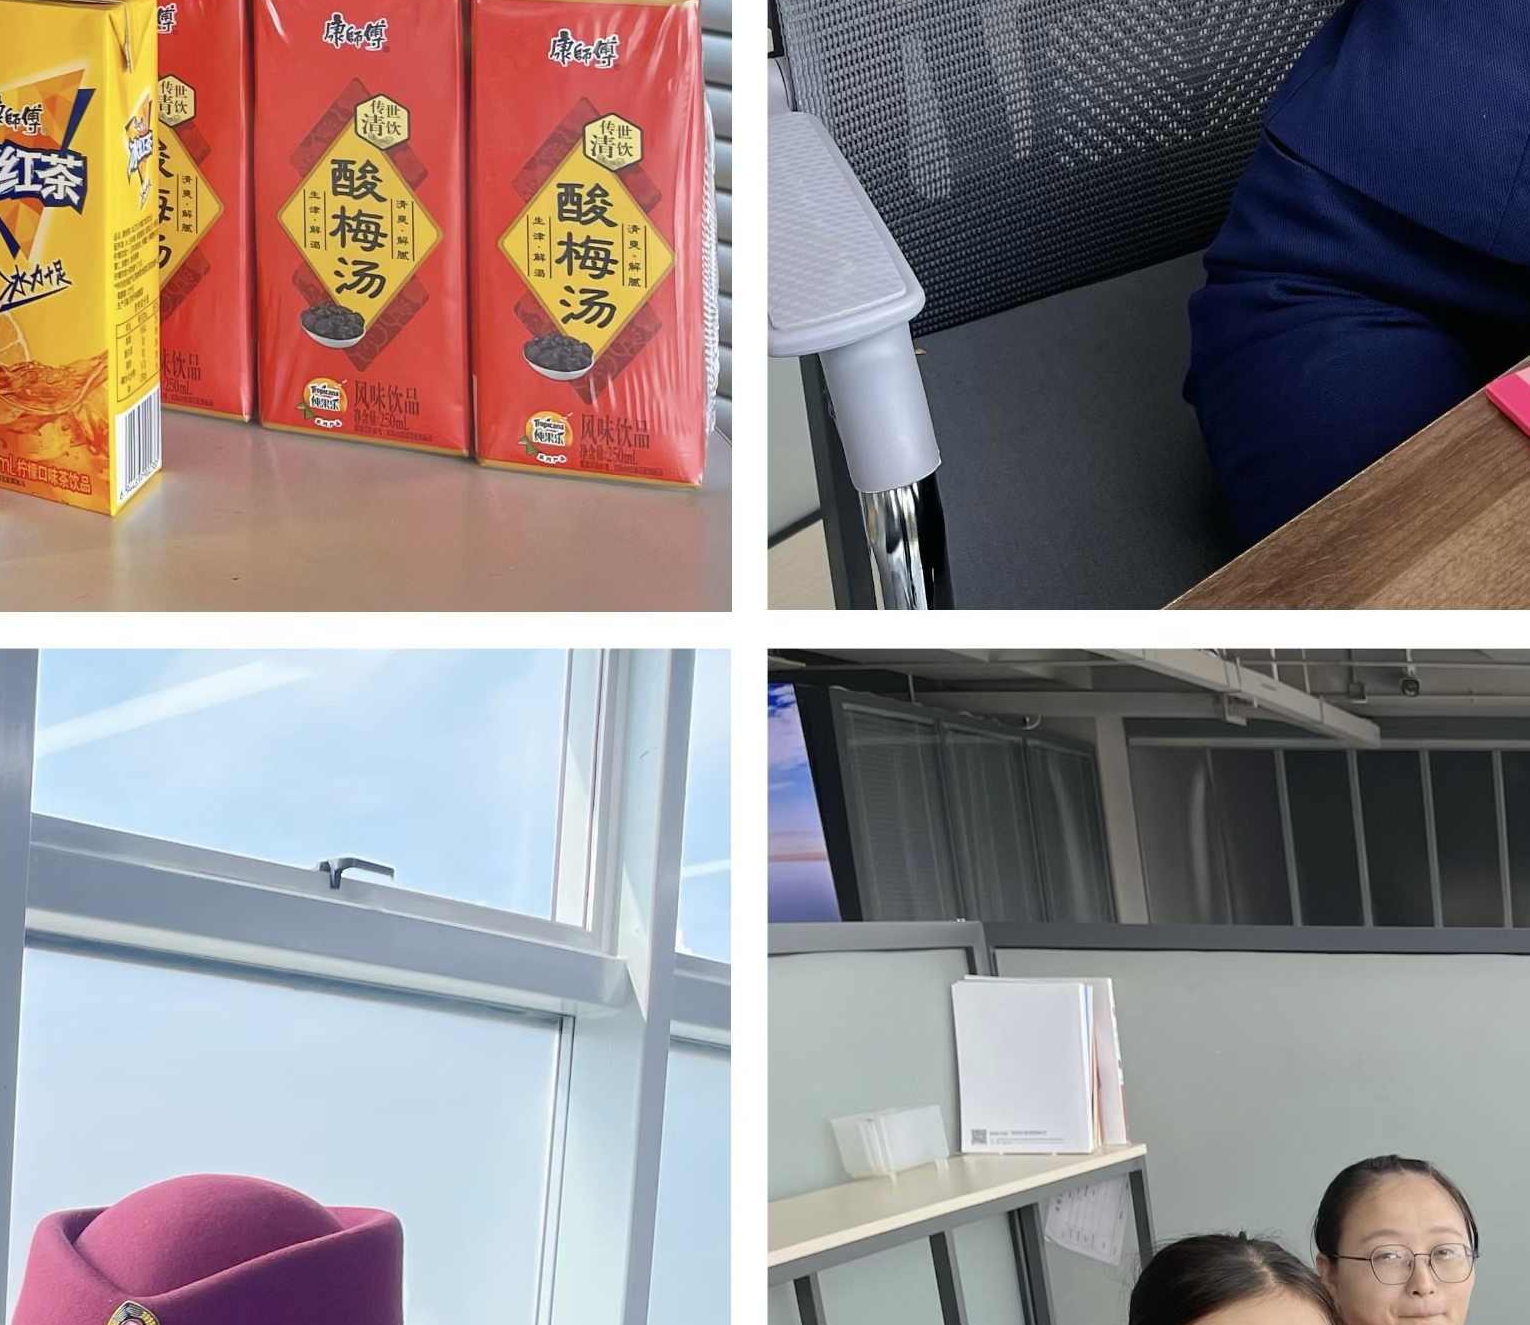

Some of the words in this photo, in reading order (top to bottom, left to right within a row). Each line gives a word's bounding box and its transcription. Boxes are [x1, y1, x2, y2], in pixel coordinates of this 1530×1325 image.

[329, 156, 389, 300] 酸梅汤
[554, 180, 619, 330] 酸梅汤
[310, 385, 339, 398] Tropicana
[354, 379, 420, 416] 风味饮品
[581, 412, 651, 449] 风味饮品
[17, 458, 91, 494] 柠檬口味茶饮品
